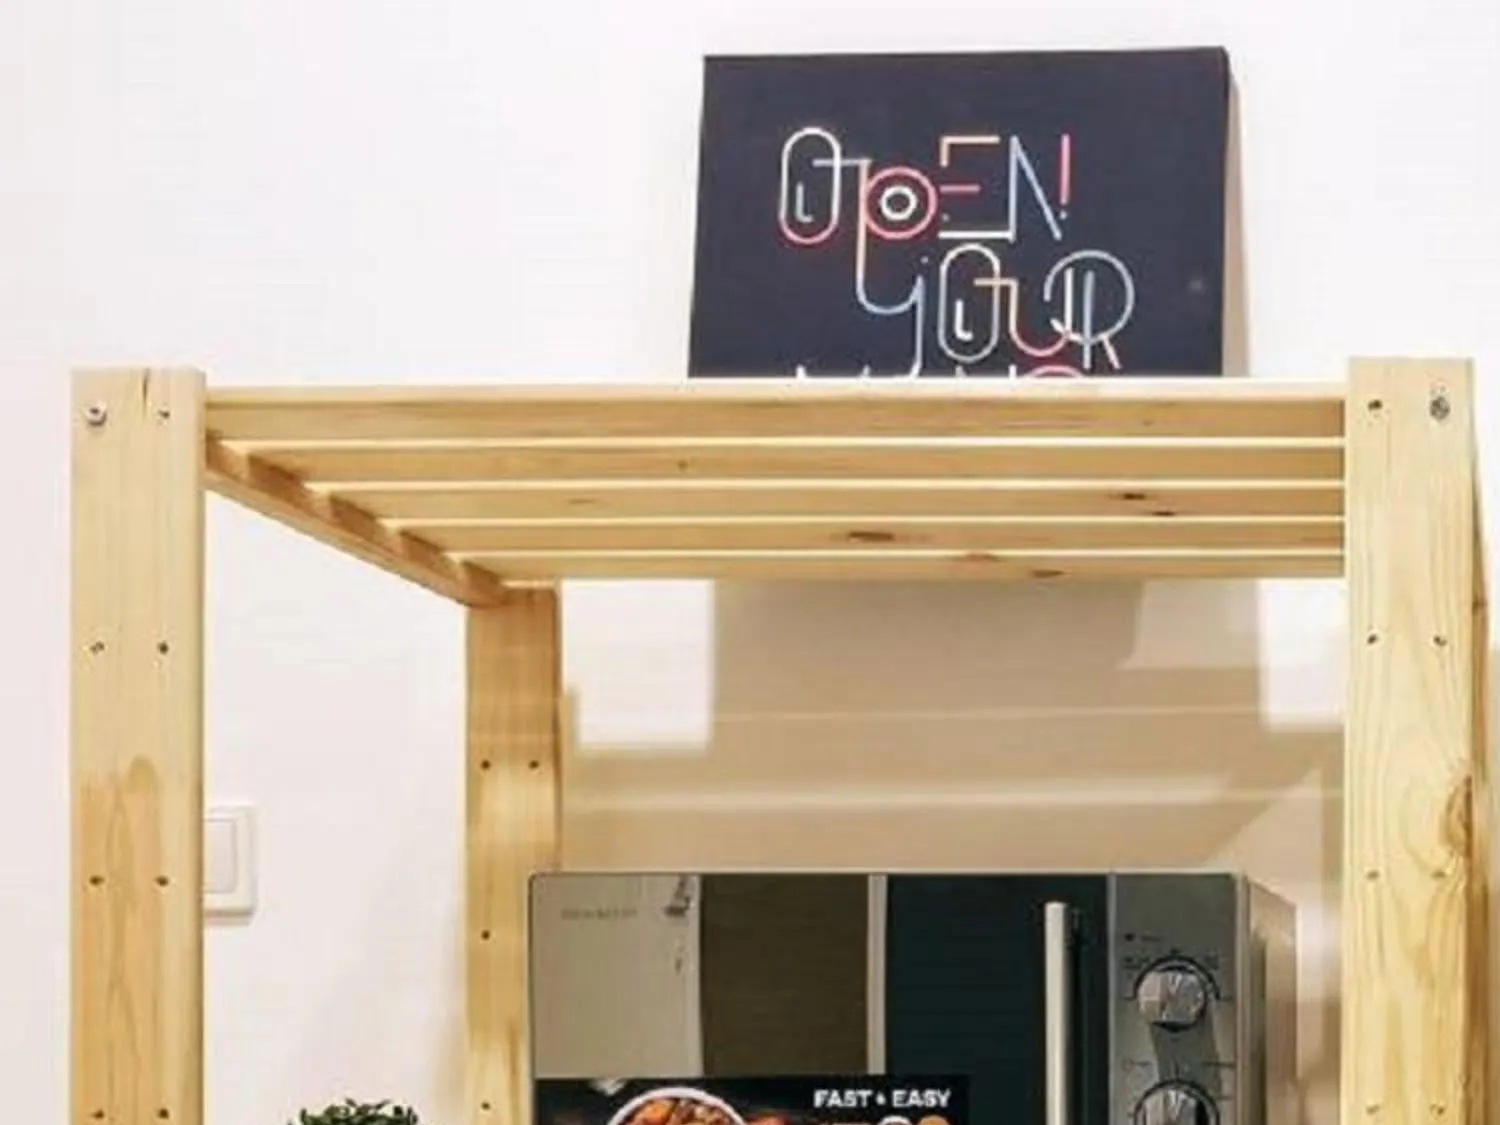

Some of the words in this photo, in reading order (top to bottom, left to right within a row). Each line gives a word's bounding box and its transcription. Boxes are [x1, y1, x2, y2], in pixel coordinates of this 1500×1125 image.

[856, 243, 1135, 376] YOUR
[813, 1089, 873, 1108] FAST
[892, 1089, 952, 1108] EASY
